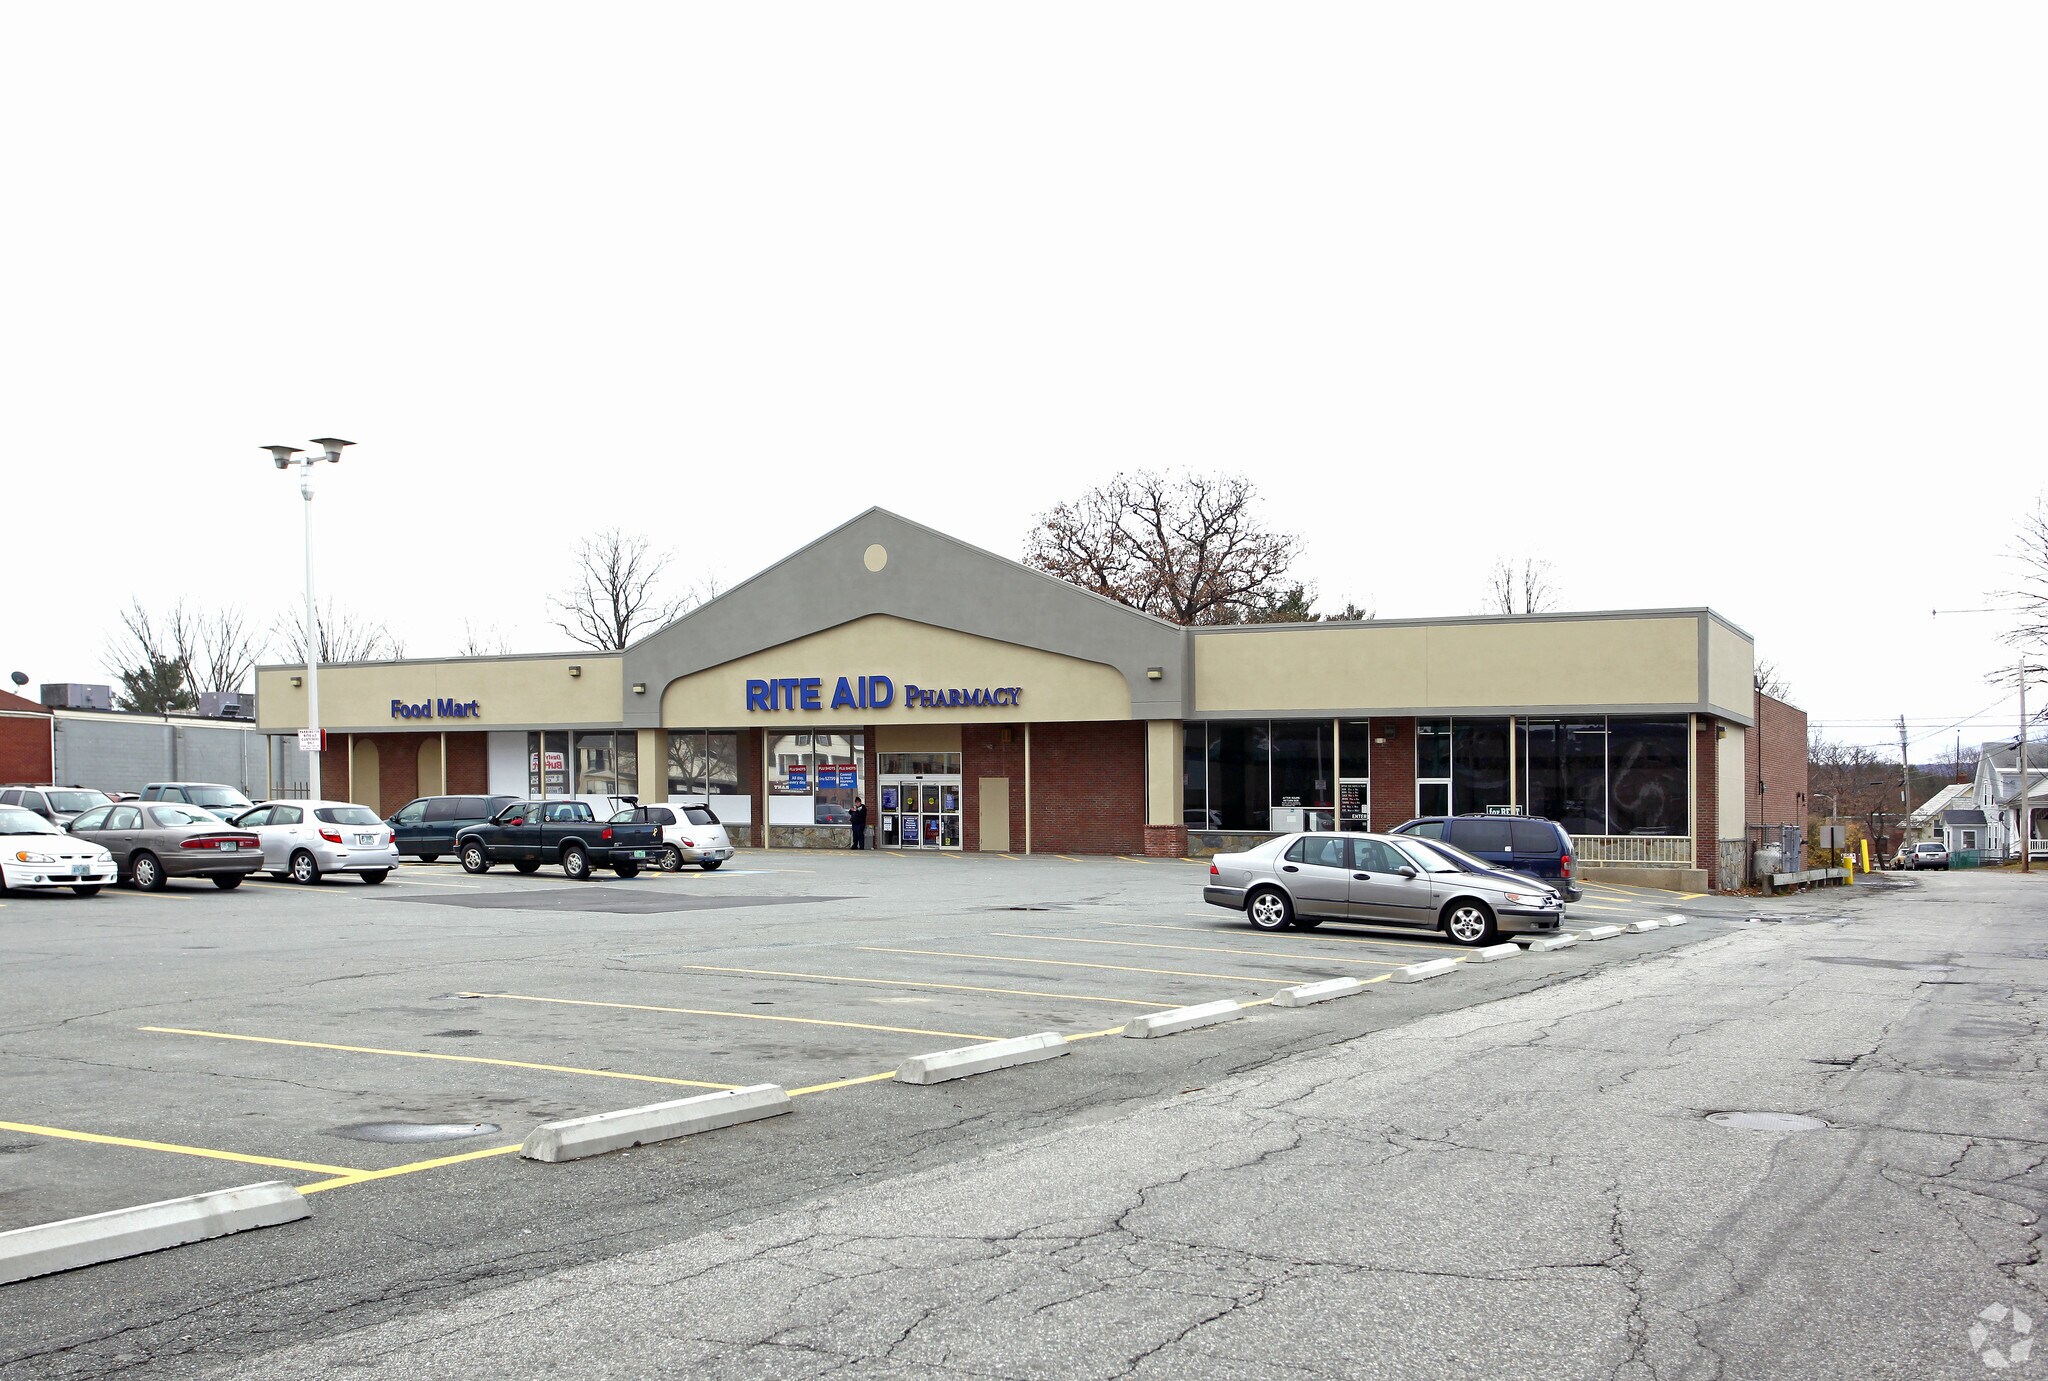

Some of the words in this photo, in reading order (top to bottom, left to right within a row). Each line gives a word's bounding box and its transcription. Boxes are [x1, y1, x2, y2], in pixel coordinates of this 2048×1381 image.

[746, 678, 823, 711] RITE
[830, 675, 895, 710] AID
[904, 684, 1023, 708] PHARMACY
[391, 698, 434, 719] Food
[437, 698, 480, 718] Mart
[1500, 807, 1520, 815] RET
